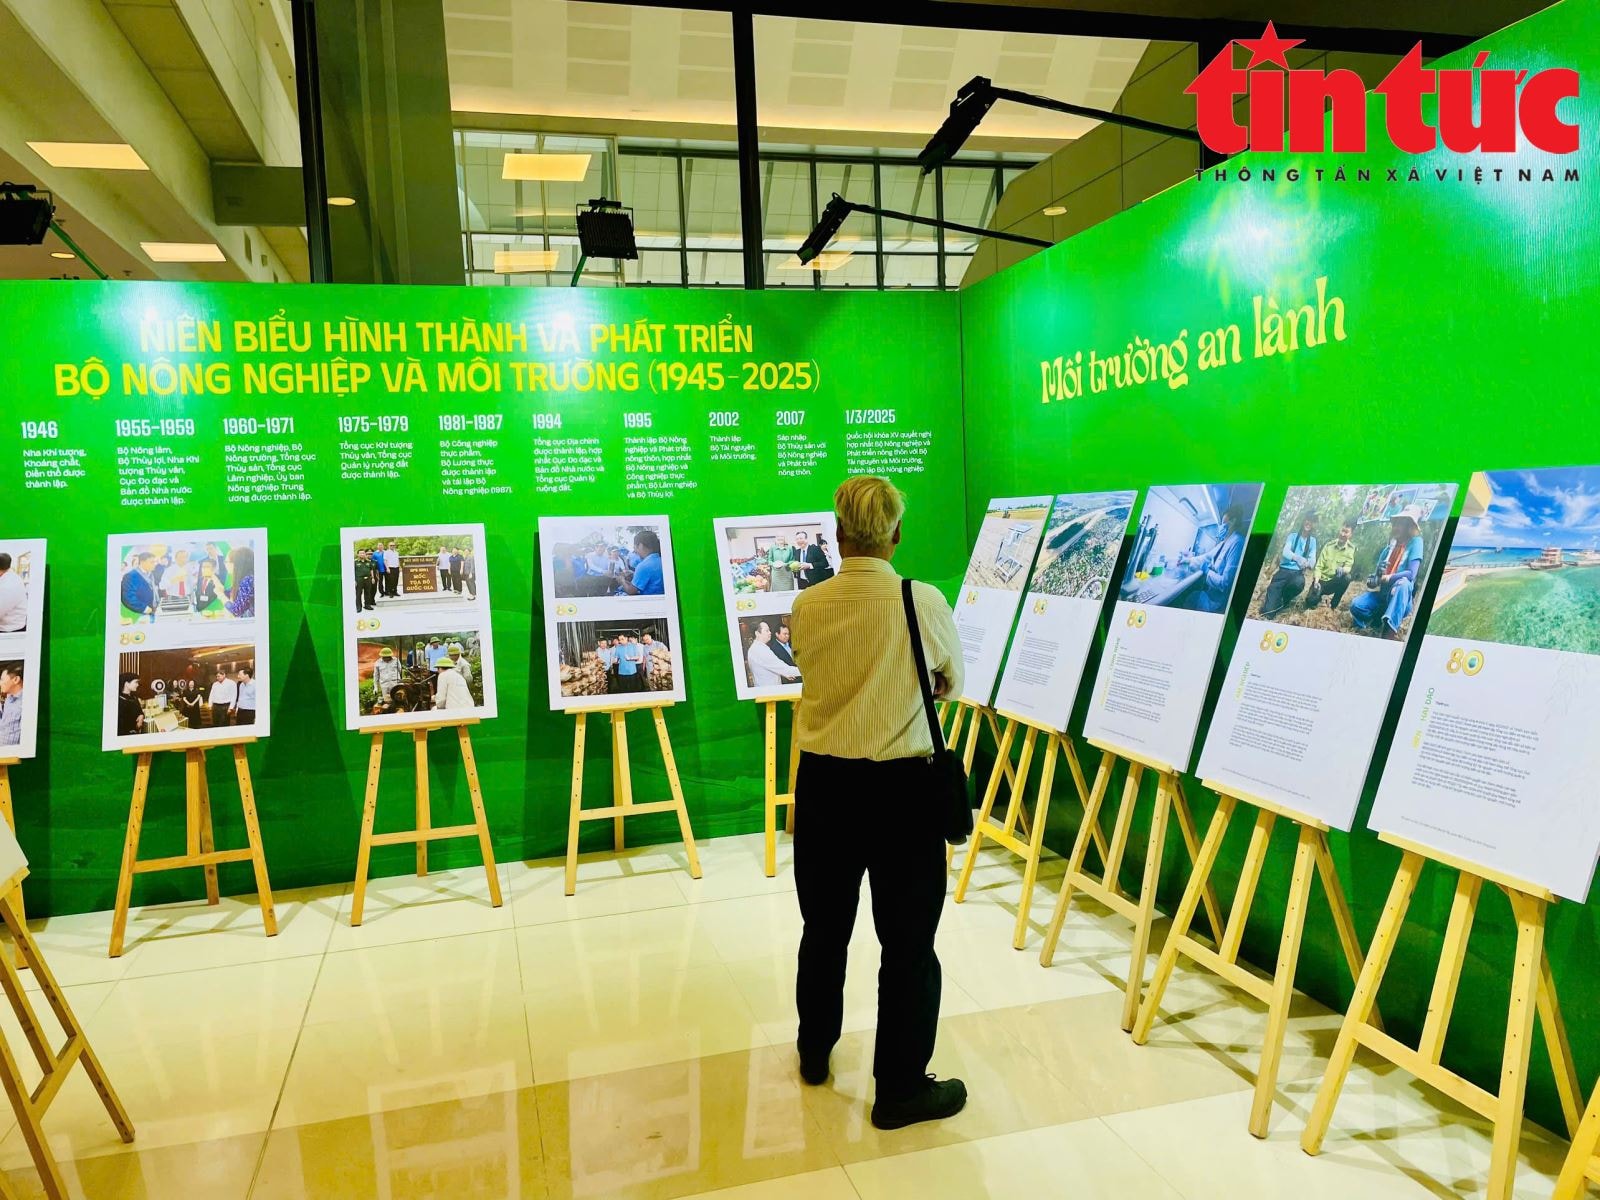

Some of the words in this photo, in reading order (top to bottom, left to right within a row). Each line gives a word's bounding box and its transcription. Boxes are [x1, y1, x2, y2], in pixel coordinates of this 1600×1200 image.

[140, 313, 221, 353] NIÊN
[235, 308, 312, 353] BIỂU
[324, 315, 407, 353] HÌNH
[416, 316, 527, 353] THÀNH
[590, 318, 666, 353] PHÁT
[674, 313, 753, 353] TRIỂN
[1041, 351, 1083, 404] Môi
[1088, 329, 1189, 394] trường
[1197, 324, 1243, 371] an
[1253, 275, 1347, 358] lành
[54, 356, 110, 400] BỘ
[123, 357, 232, 395] NÔNG
[244, 356, 371, 397] NGHIỆP
[383, 356, 428, 393] VÀ
[438, 356, 501, 393] MÔI
[509, 357, 640, 393] TRƯỜNG
[532, 414, 562, 428] 1994
[624, 413, 652, 428] 1995
[709, 412, 740, 426] 2002
[776, 410, 805, 426] 2007
[846, 410, 896, 424] 1/3/2025
[22, 421, 58, 438] 1946
[1260, 629, 1289, 653] 80
[1446, 647, 1485, 677] 80
